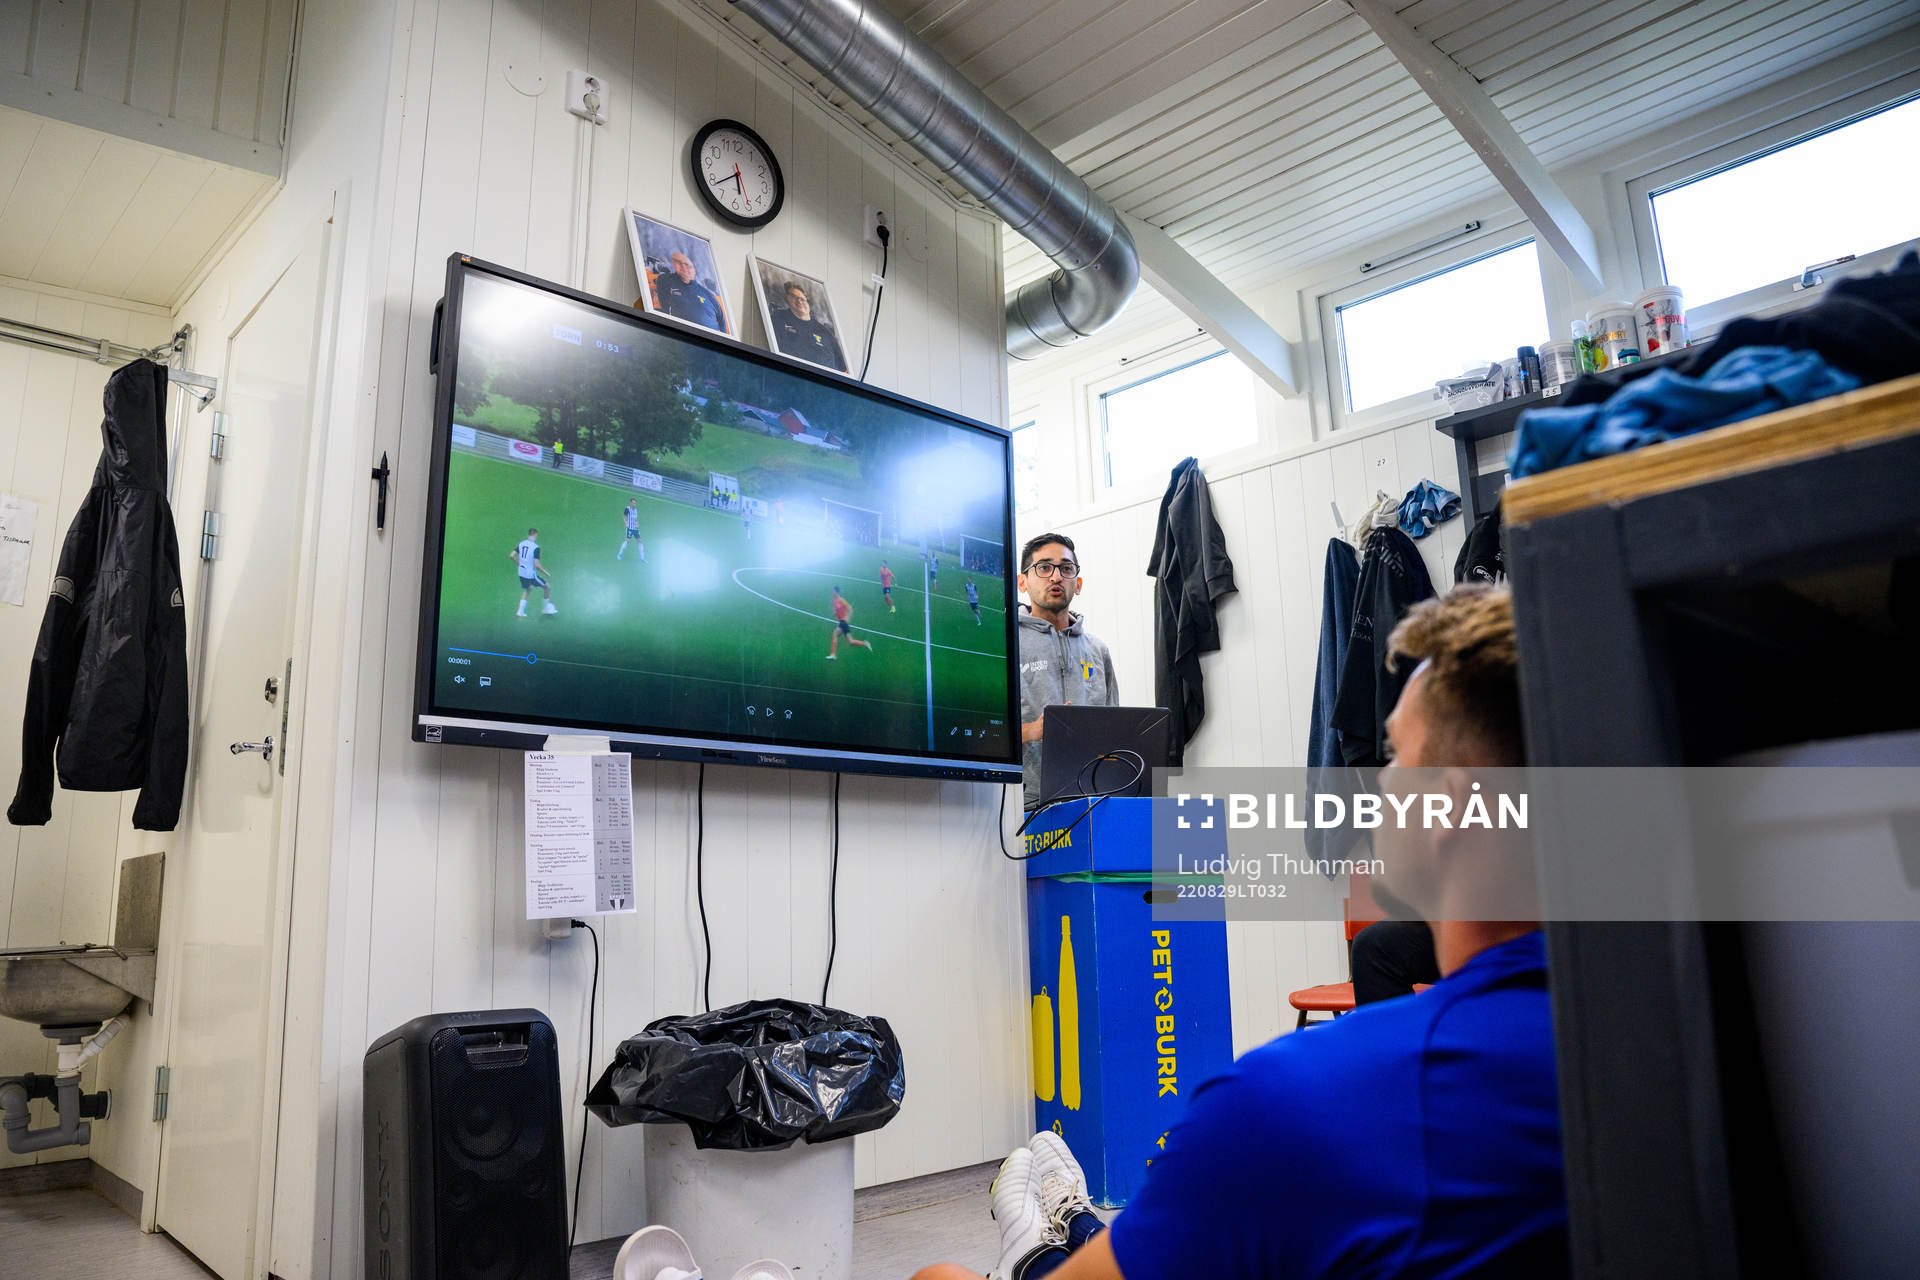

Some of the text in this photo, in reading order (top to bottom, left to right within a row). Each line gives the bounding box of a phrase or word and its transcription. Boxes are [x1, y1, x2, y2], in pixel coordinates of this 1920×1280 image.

[722, 138, 730, 152] 11
[732, 140, 744, 155] 12
[710, 145, 720, 160] 10
[749, 151, 753, 162] 1
[704, 157, 713, 170] 9
[758, 165, 765, 179] 2
[708, 173, 716, 187] 8
[718, 188, 725, 200] 7
[761, 181, 768, 195] 3
[731, 198, 740, 210] 6
[744, 200, 753, 211] 5
[755, 195, 762, 207] 4
[1151, 930, 1178, 1098] PET BURK
